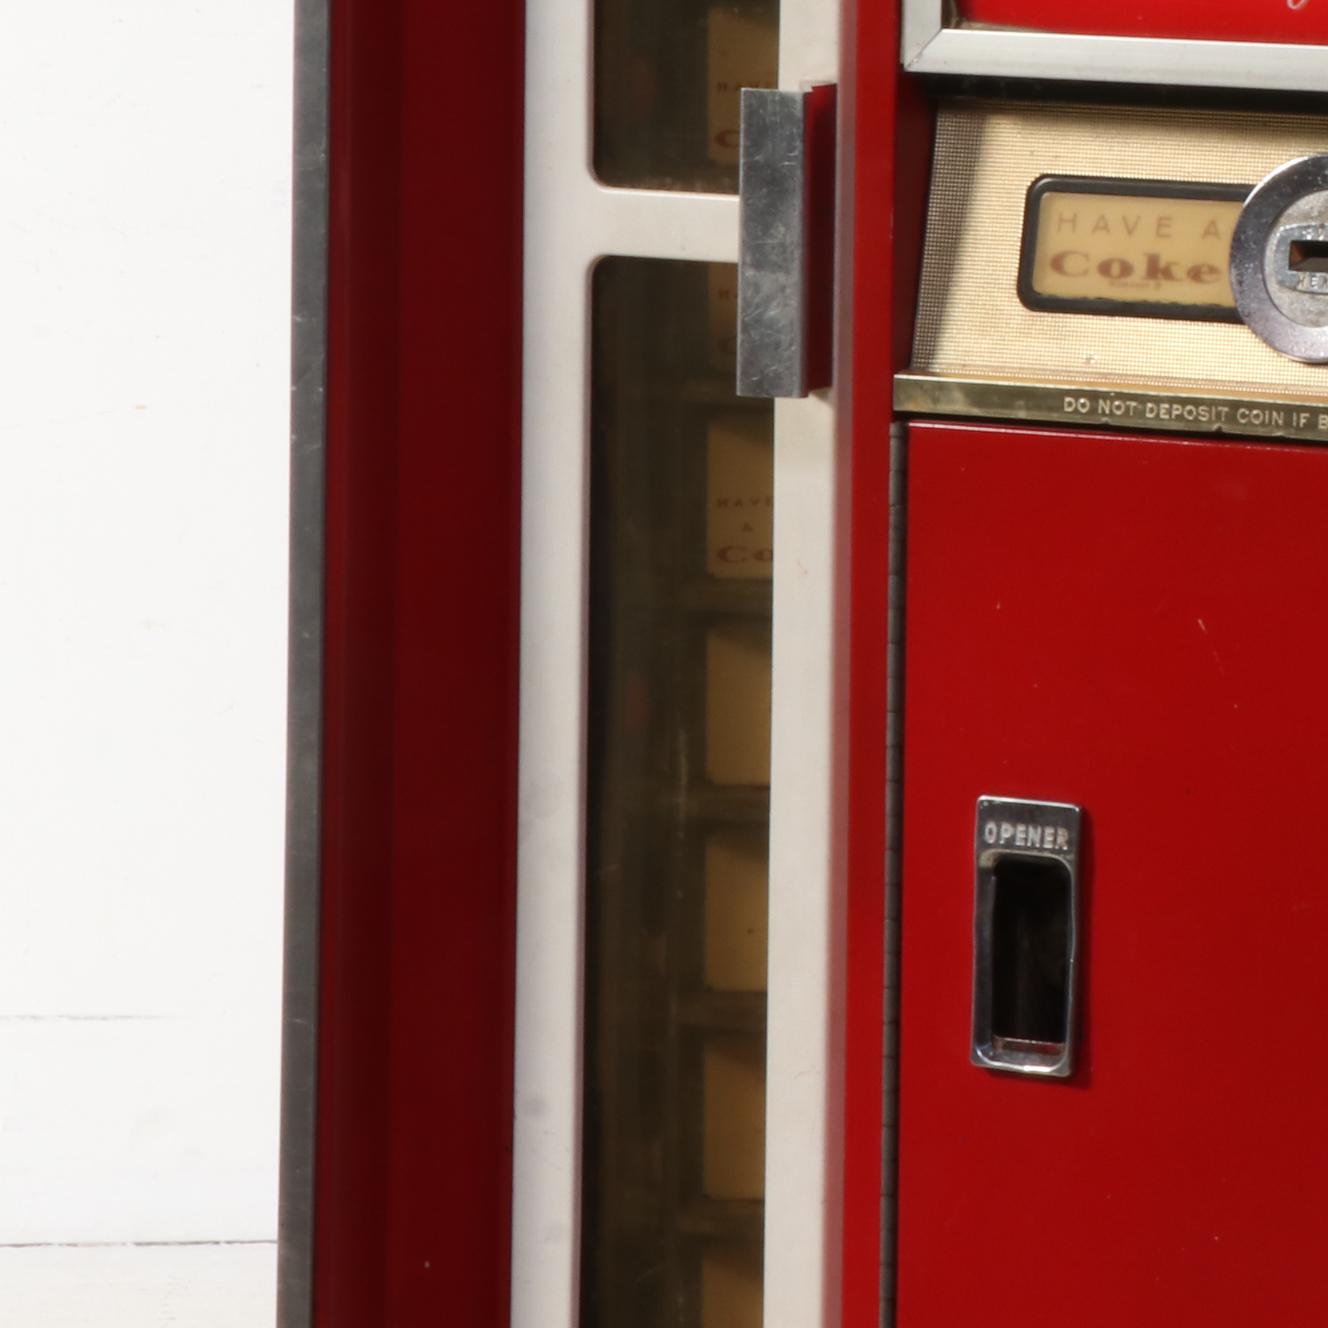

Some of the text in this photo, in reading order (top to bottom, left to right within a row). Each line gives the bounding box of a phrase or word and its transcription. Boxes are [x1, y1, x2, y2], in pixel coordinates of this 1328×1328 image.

[1057, 213, 1221, 241] HAVE A
[1050, 250, 1223, 284] Coke
[1063, 396, 1091, 414] DO
[1098, 400, 1138, 417] NOT
[1145, 403, 1229, 423] DEPOSIT
[1236, 408, 1285, 427] COIN
[1292, 412, 1308, 429] IF
[983, 822, 1070, 851] OPENER
